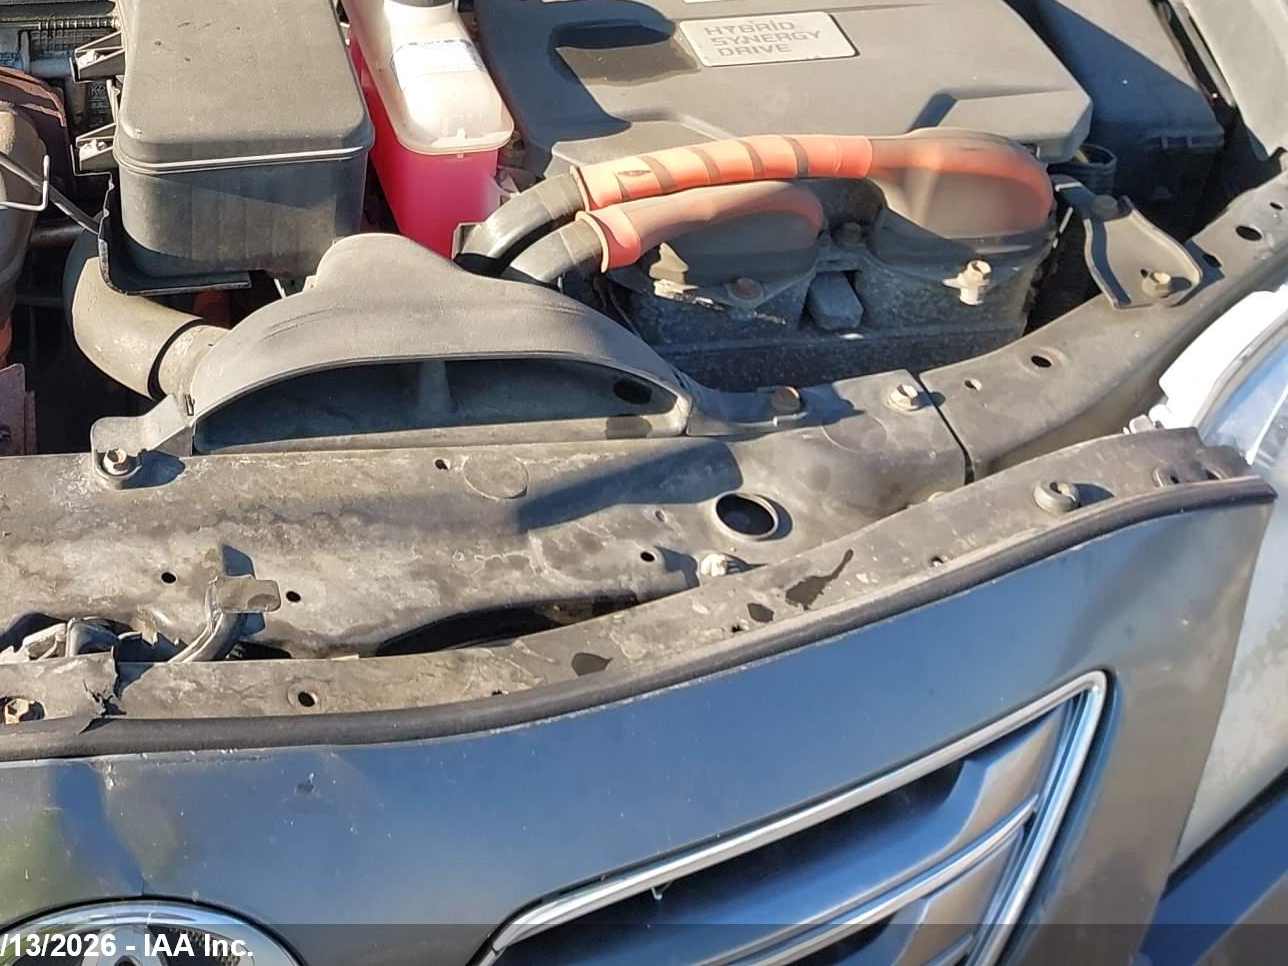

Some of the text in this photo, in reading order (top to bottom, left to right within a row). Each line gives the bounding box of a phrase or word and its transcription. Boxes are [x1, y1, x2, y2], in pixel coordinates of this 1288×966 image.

[704, 20, 795, 36] HYBRID
[712, 30, 822, 47] SYNERGY
[717, 43, 793, 58] DRIVE
